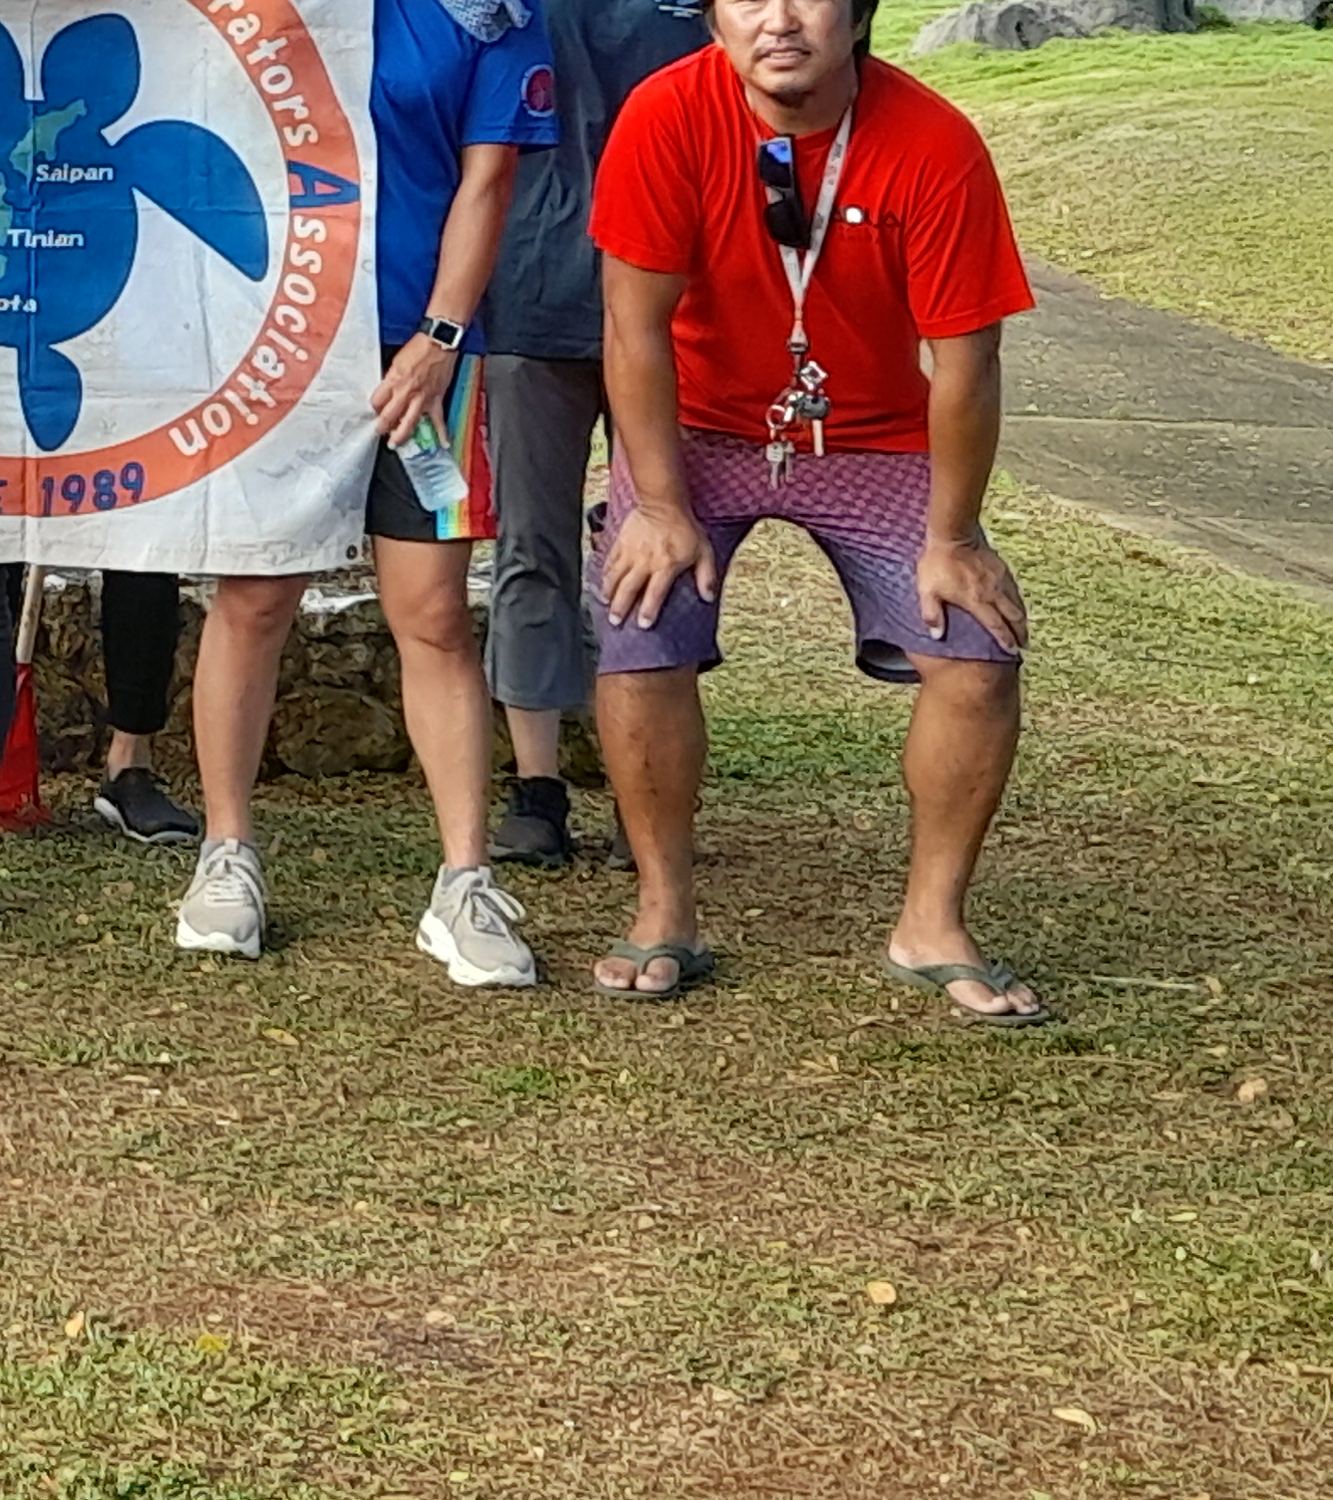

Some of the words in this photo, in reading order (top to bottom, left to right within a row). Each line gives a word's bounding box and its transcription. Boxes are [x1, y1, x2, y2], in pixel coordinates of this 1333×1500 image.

[34, 162, 115, 185] Saipan
[7, 228, 85, 248] Tinian
[167, 158, 362, 457] Association
[41, 461, 146, 518] 1989
